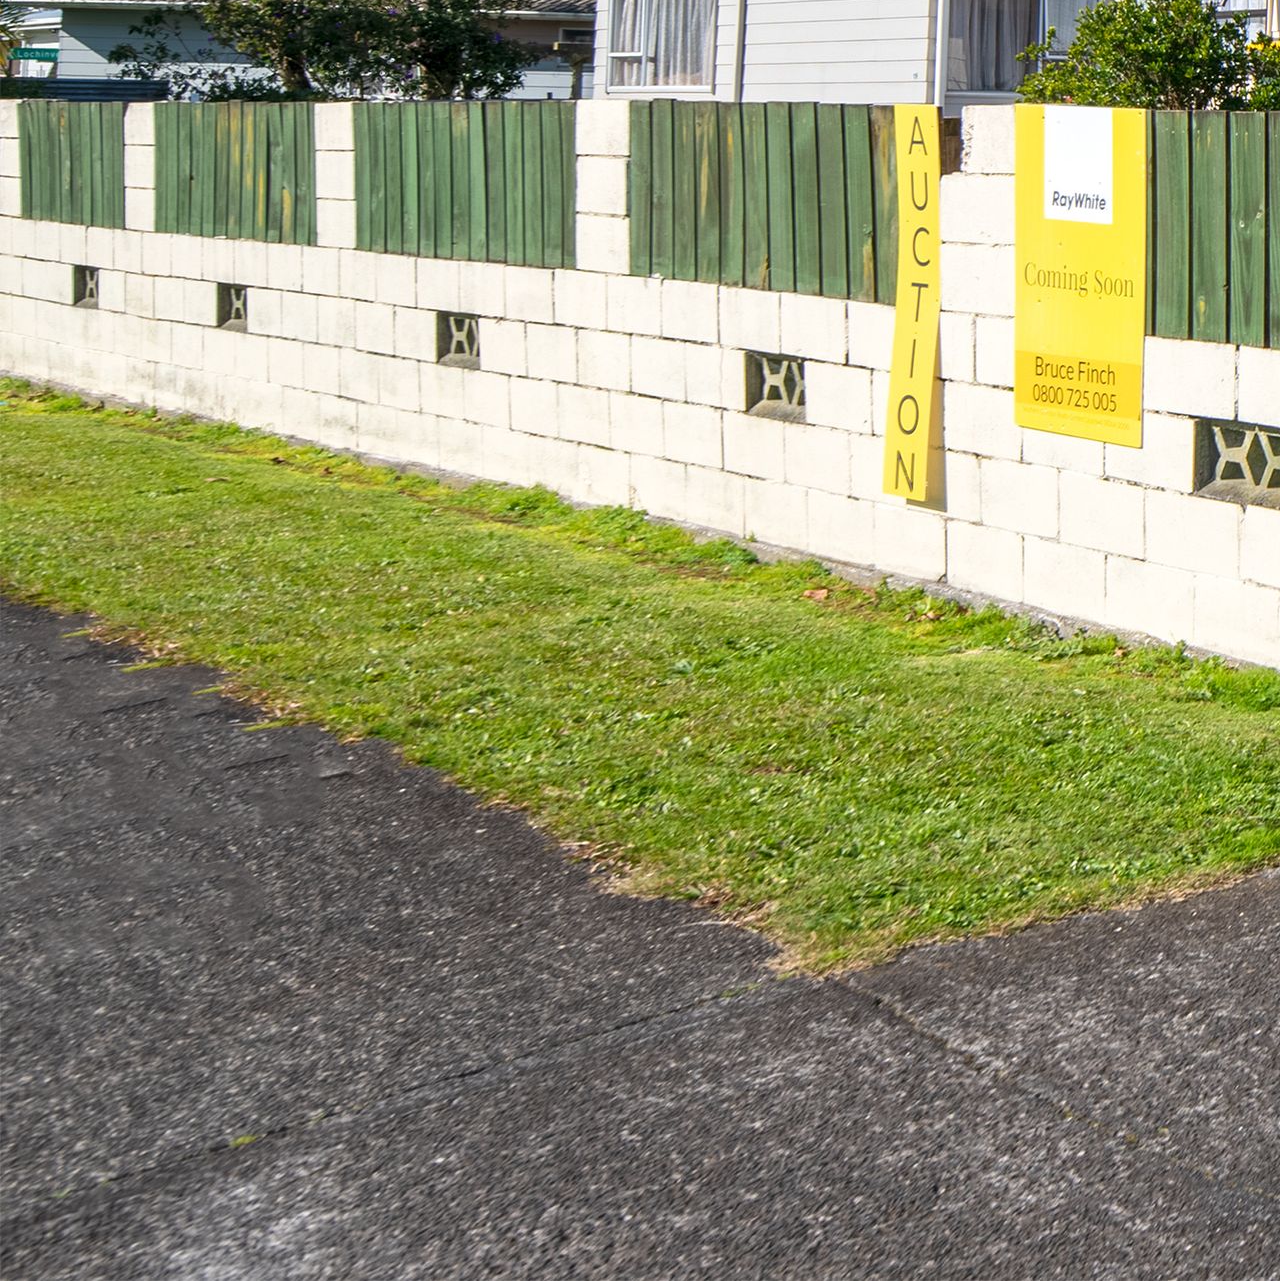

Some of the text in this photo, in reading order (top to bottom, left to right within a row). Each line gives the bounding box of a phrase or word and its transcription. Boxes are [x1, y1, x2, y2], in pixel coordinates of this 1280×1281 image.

[1024, 262, 1134, 298] Coming Soon
[895, 115, 931, 493] AUCTION
[1035, 356, 1116, 386] Bruce Finch
[1032, 383, 1117, 412] 0800 725 005
